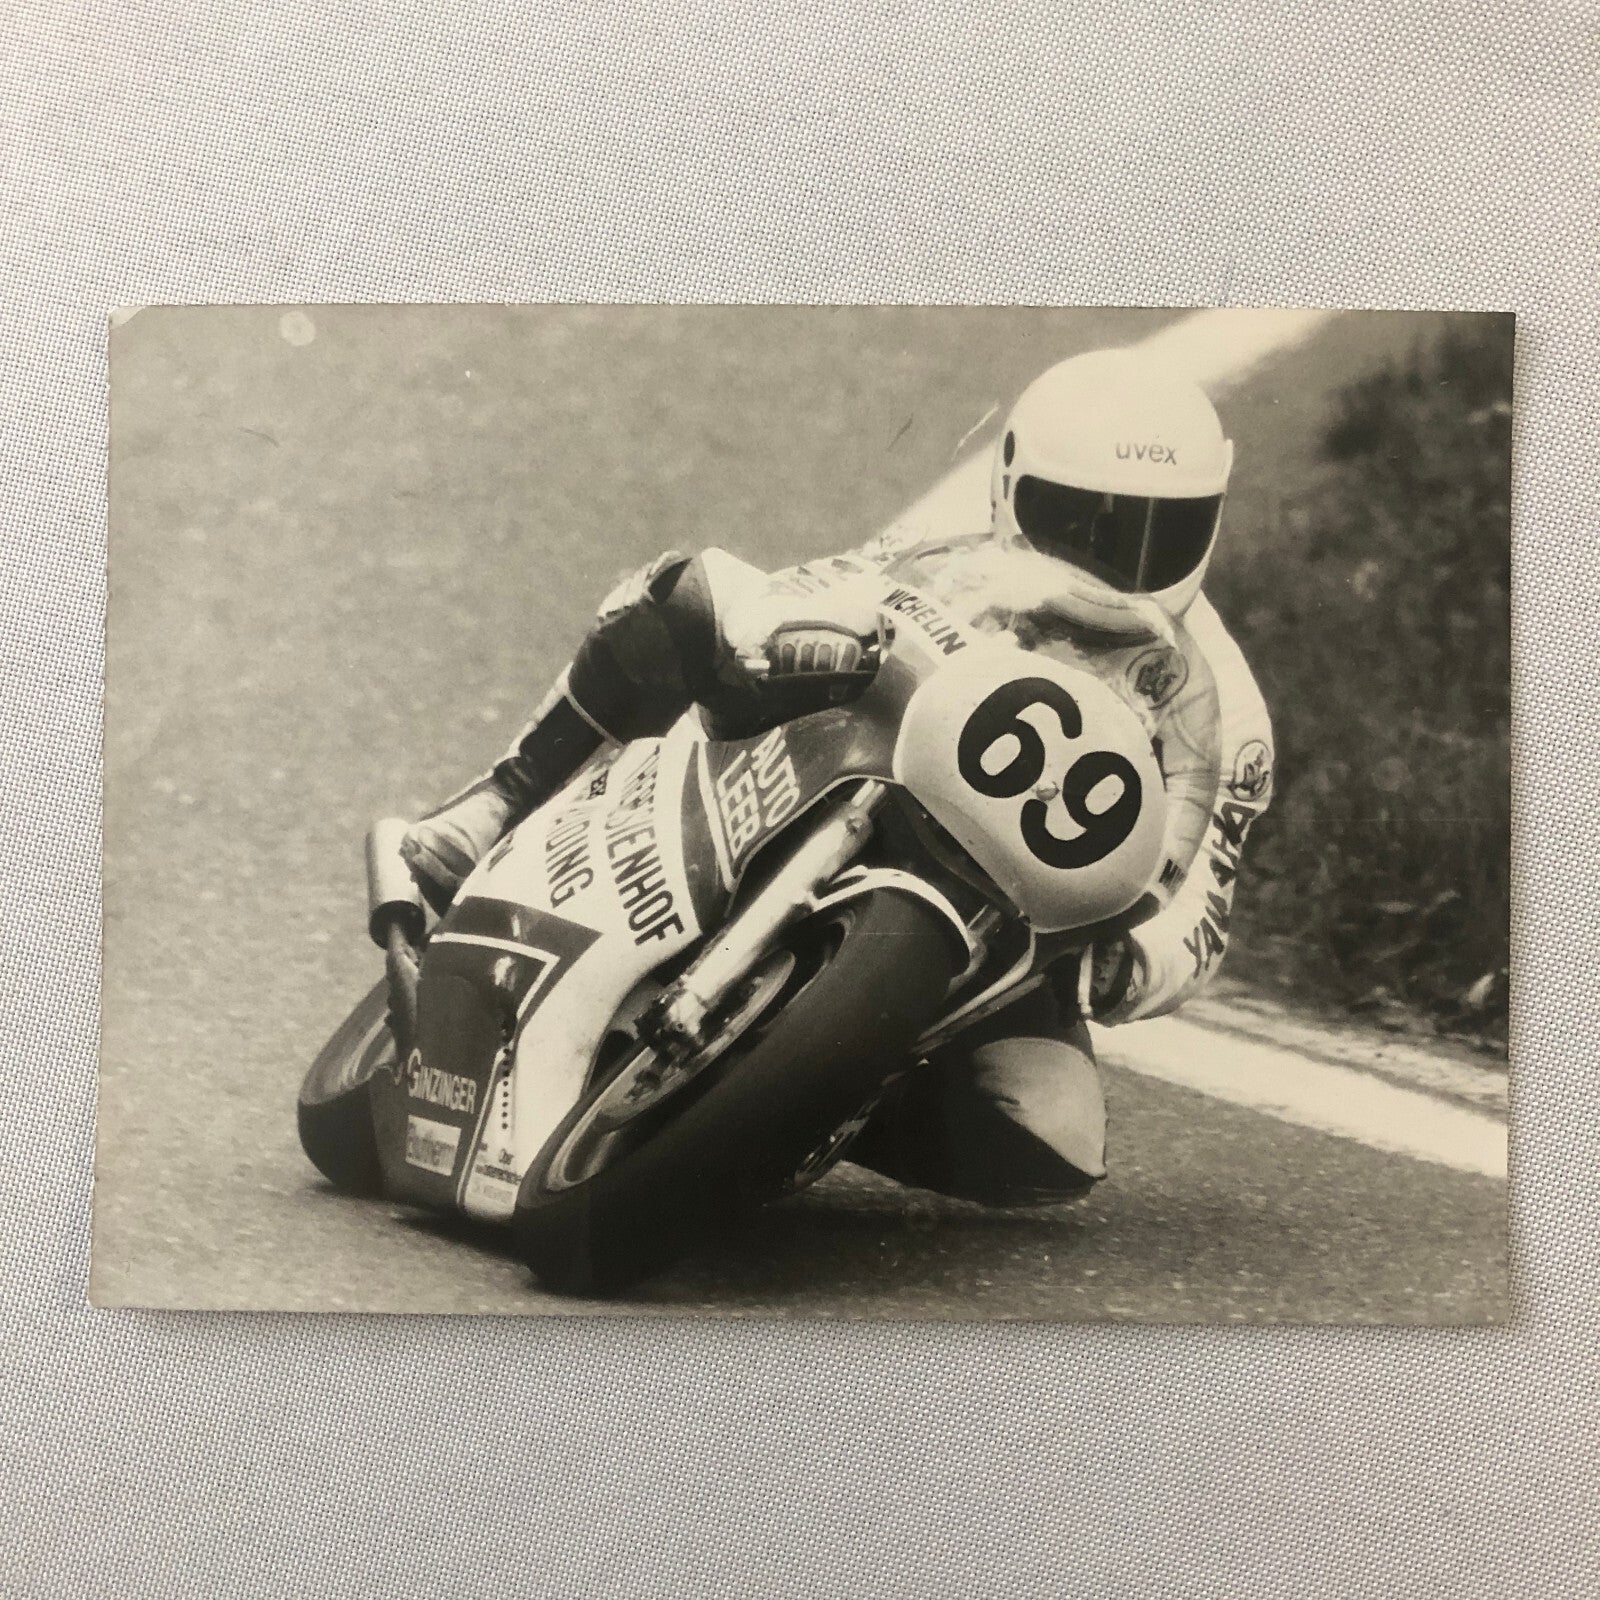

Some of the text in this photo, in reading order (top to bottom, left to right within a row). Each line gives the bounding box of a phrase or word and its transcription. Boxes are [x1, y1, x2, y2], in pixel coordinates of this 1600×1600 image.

[1115, 442, 1177, 466] uvex
[751, 726, 800, 828] AUTO
[957, 676, 1142, 869] 69
[1183, 801, 1256, 980] YAMAHA
[407, 1047, 477, 1115] GINZINGER
